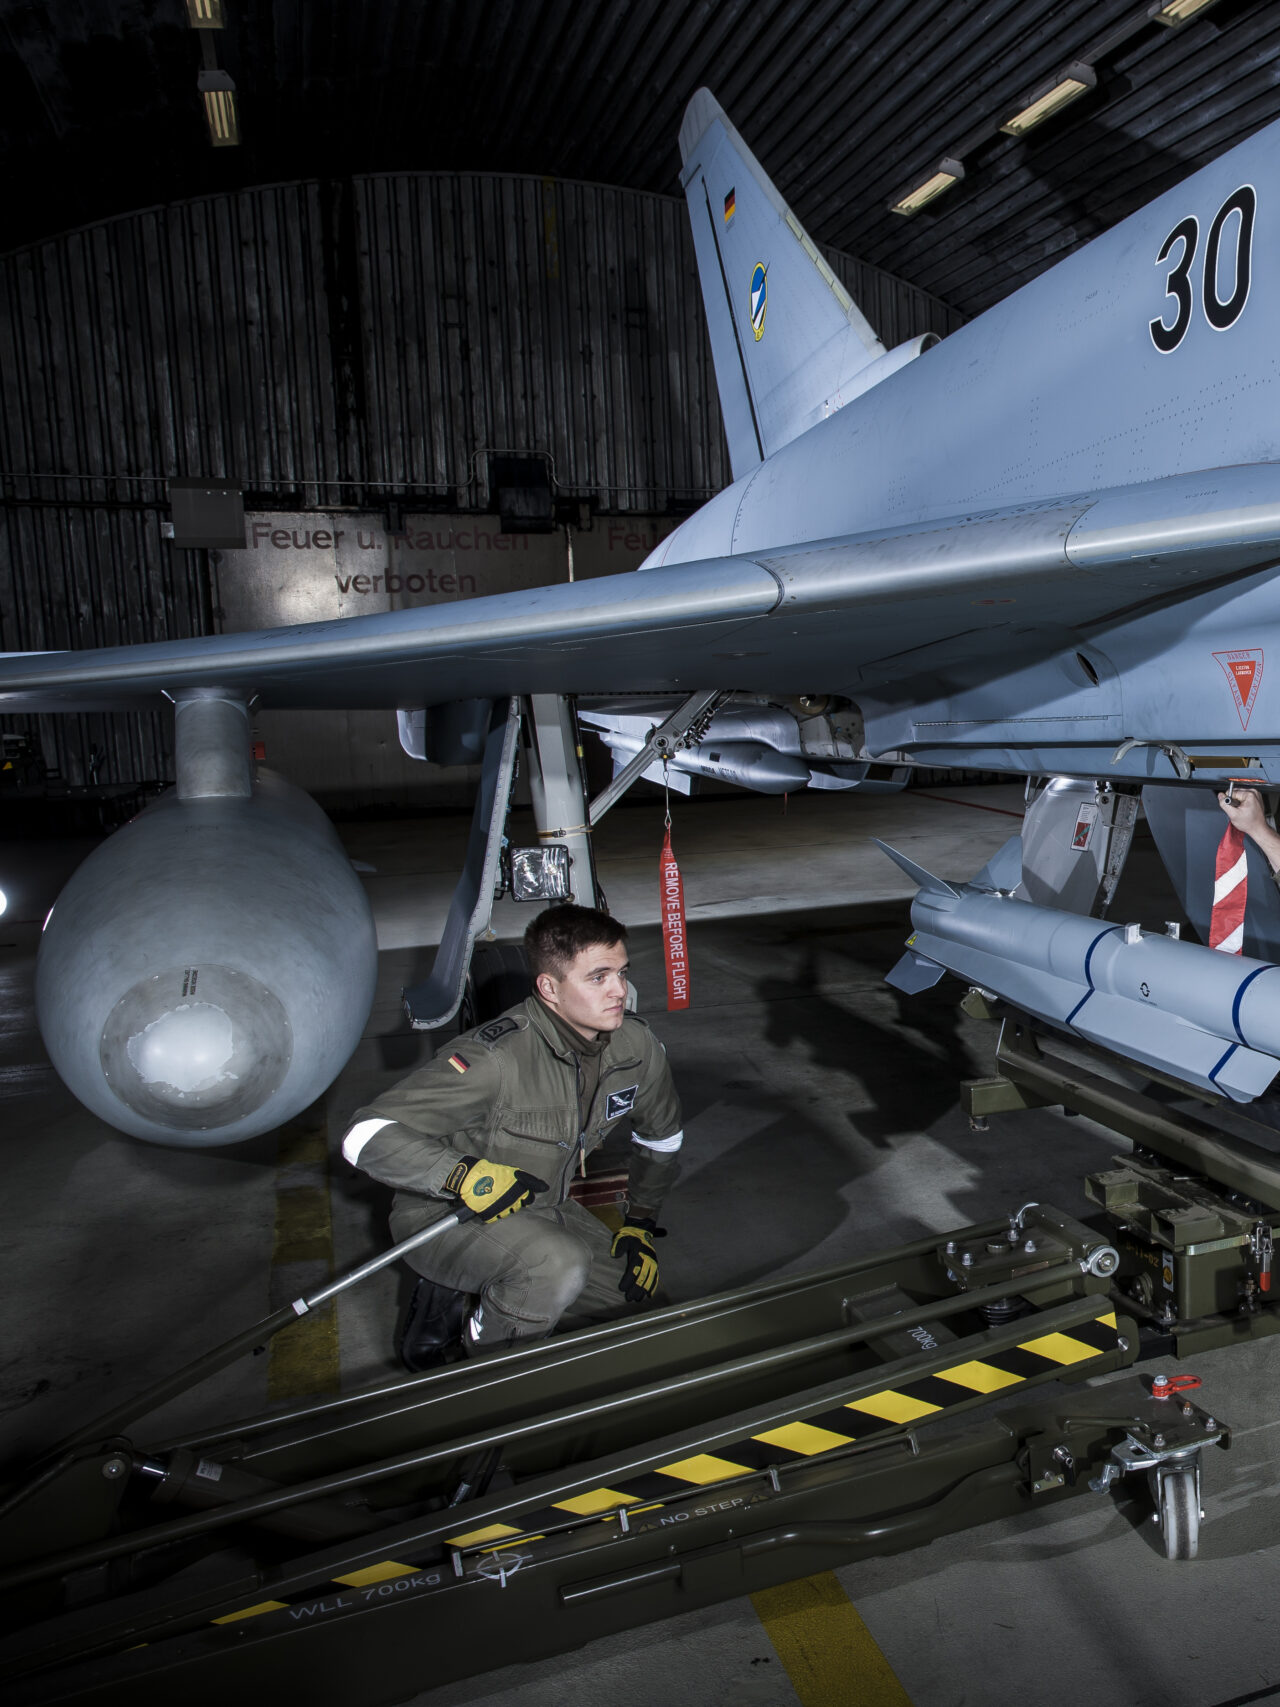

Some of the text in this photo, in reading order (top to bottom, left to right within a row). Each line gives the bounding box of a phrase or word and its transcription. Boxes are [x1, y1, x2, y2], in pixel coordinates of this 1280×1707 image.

[1149, 184, 1257, 354] 30
[251, 522, 529, 551] Feuer u. Rauchen
[334, 568, 477, 594] verboten
[664, 862, 681, 911] REMOVE
[667, 912, 684, 960] BEFORE
[671, 961, 687, 1001] FLIGHT
[906, 1326, 938, 1350] 700kg
[659, 1498, 744, 1526] NO STEP
[288, 1573, 441, 1620] WLL 700kg
